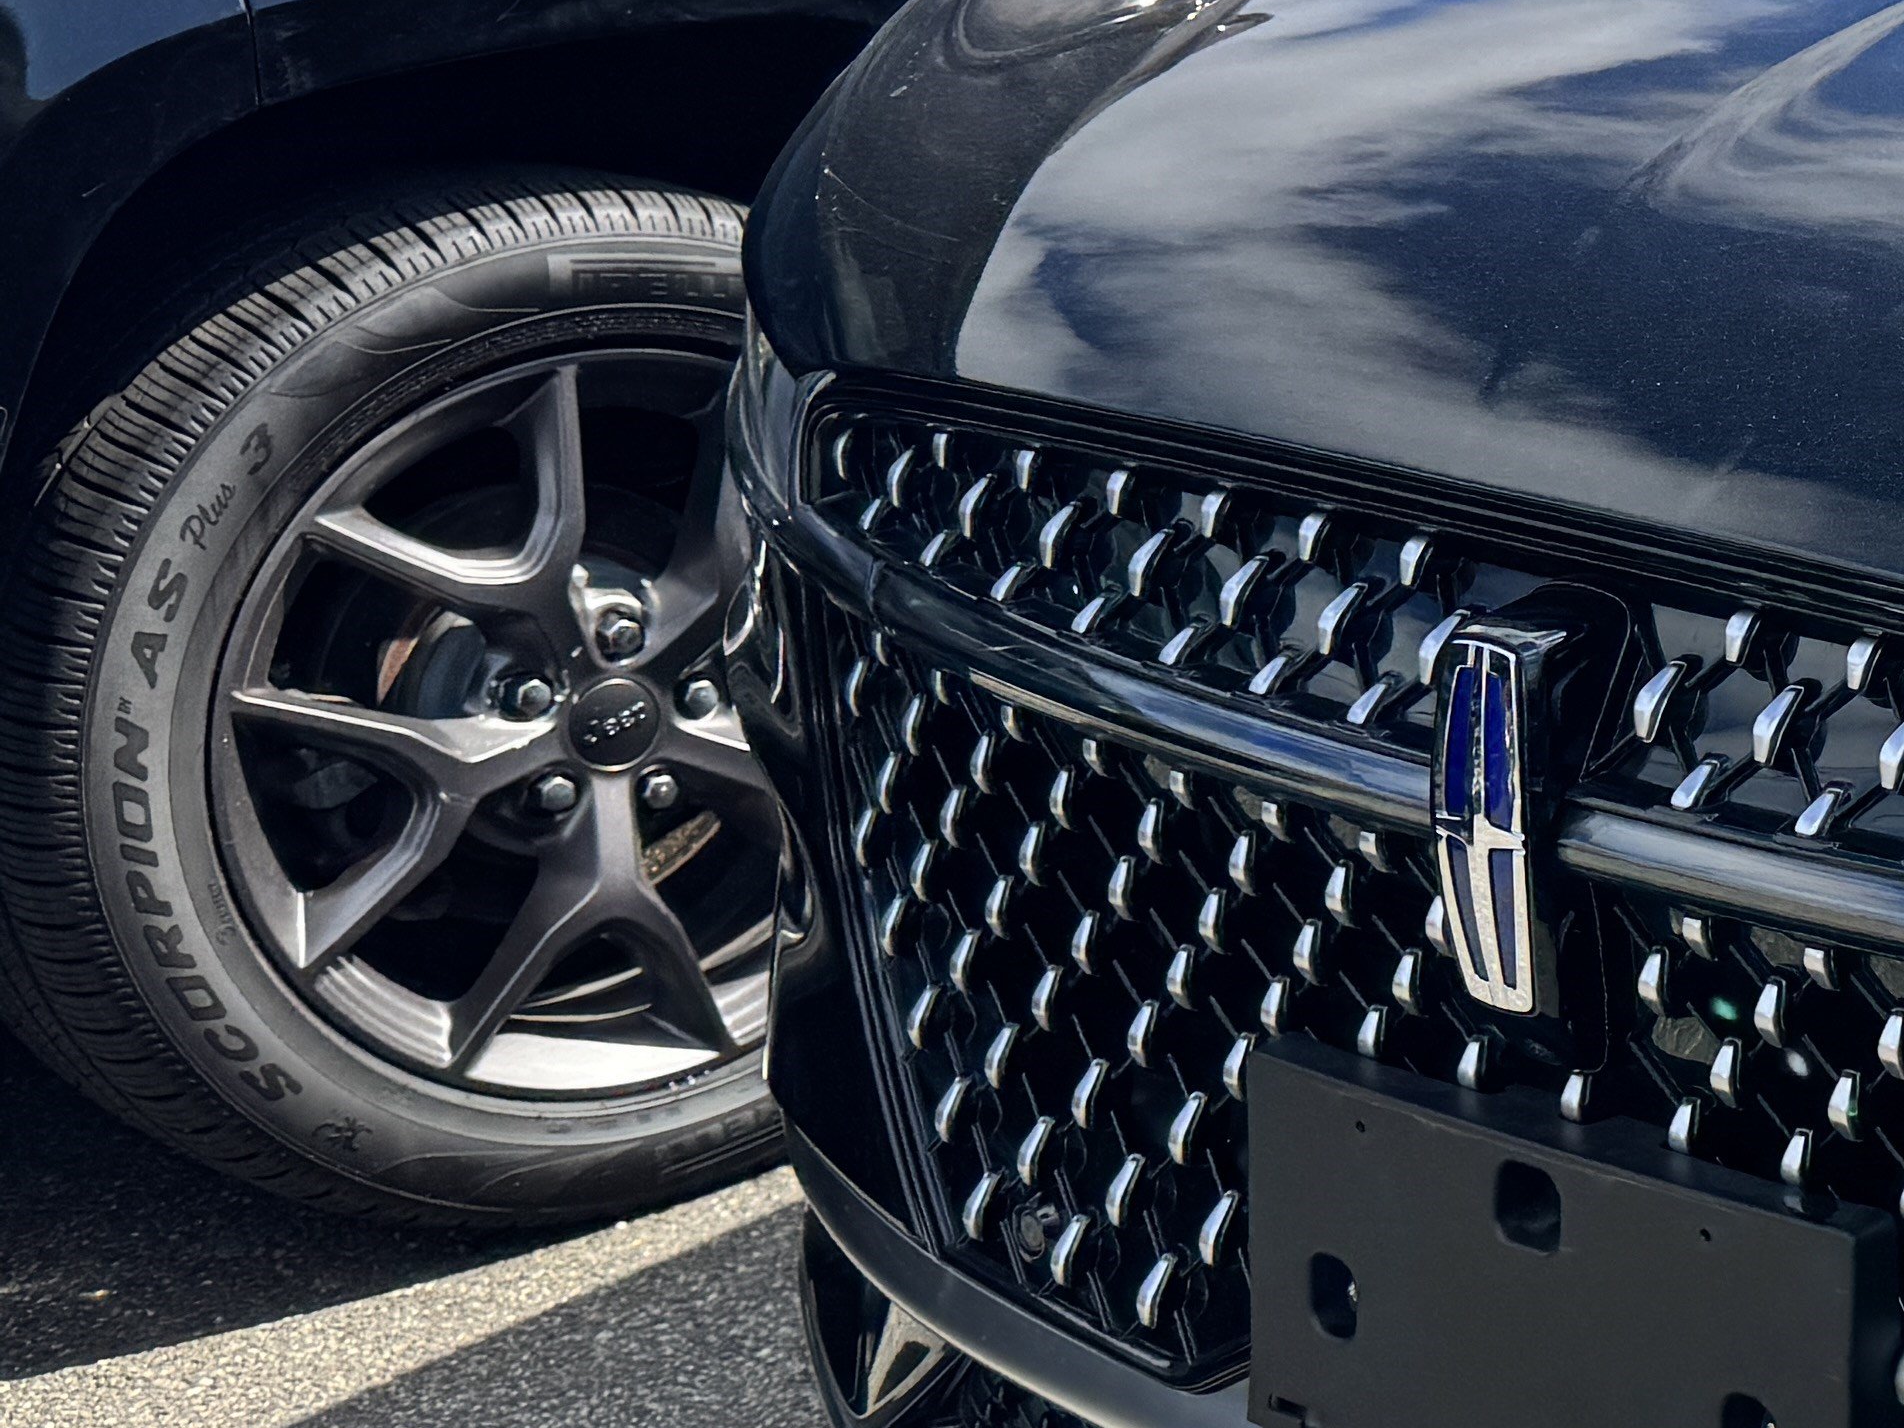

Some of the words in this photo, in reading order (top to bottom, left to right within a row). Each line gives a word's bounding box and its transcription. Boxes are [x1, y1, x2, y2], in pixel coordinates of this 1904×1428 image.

[239, 422, 274, 476] 3
[179, 482, 237, 551] Plus
[130, 558, 189, 690] AS
[112, 716, 304, 1102] SCORPION
